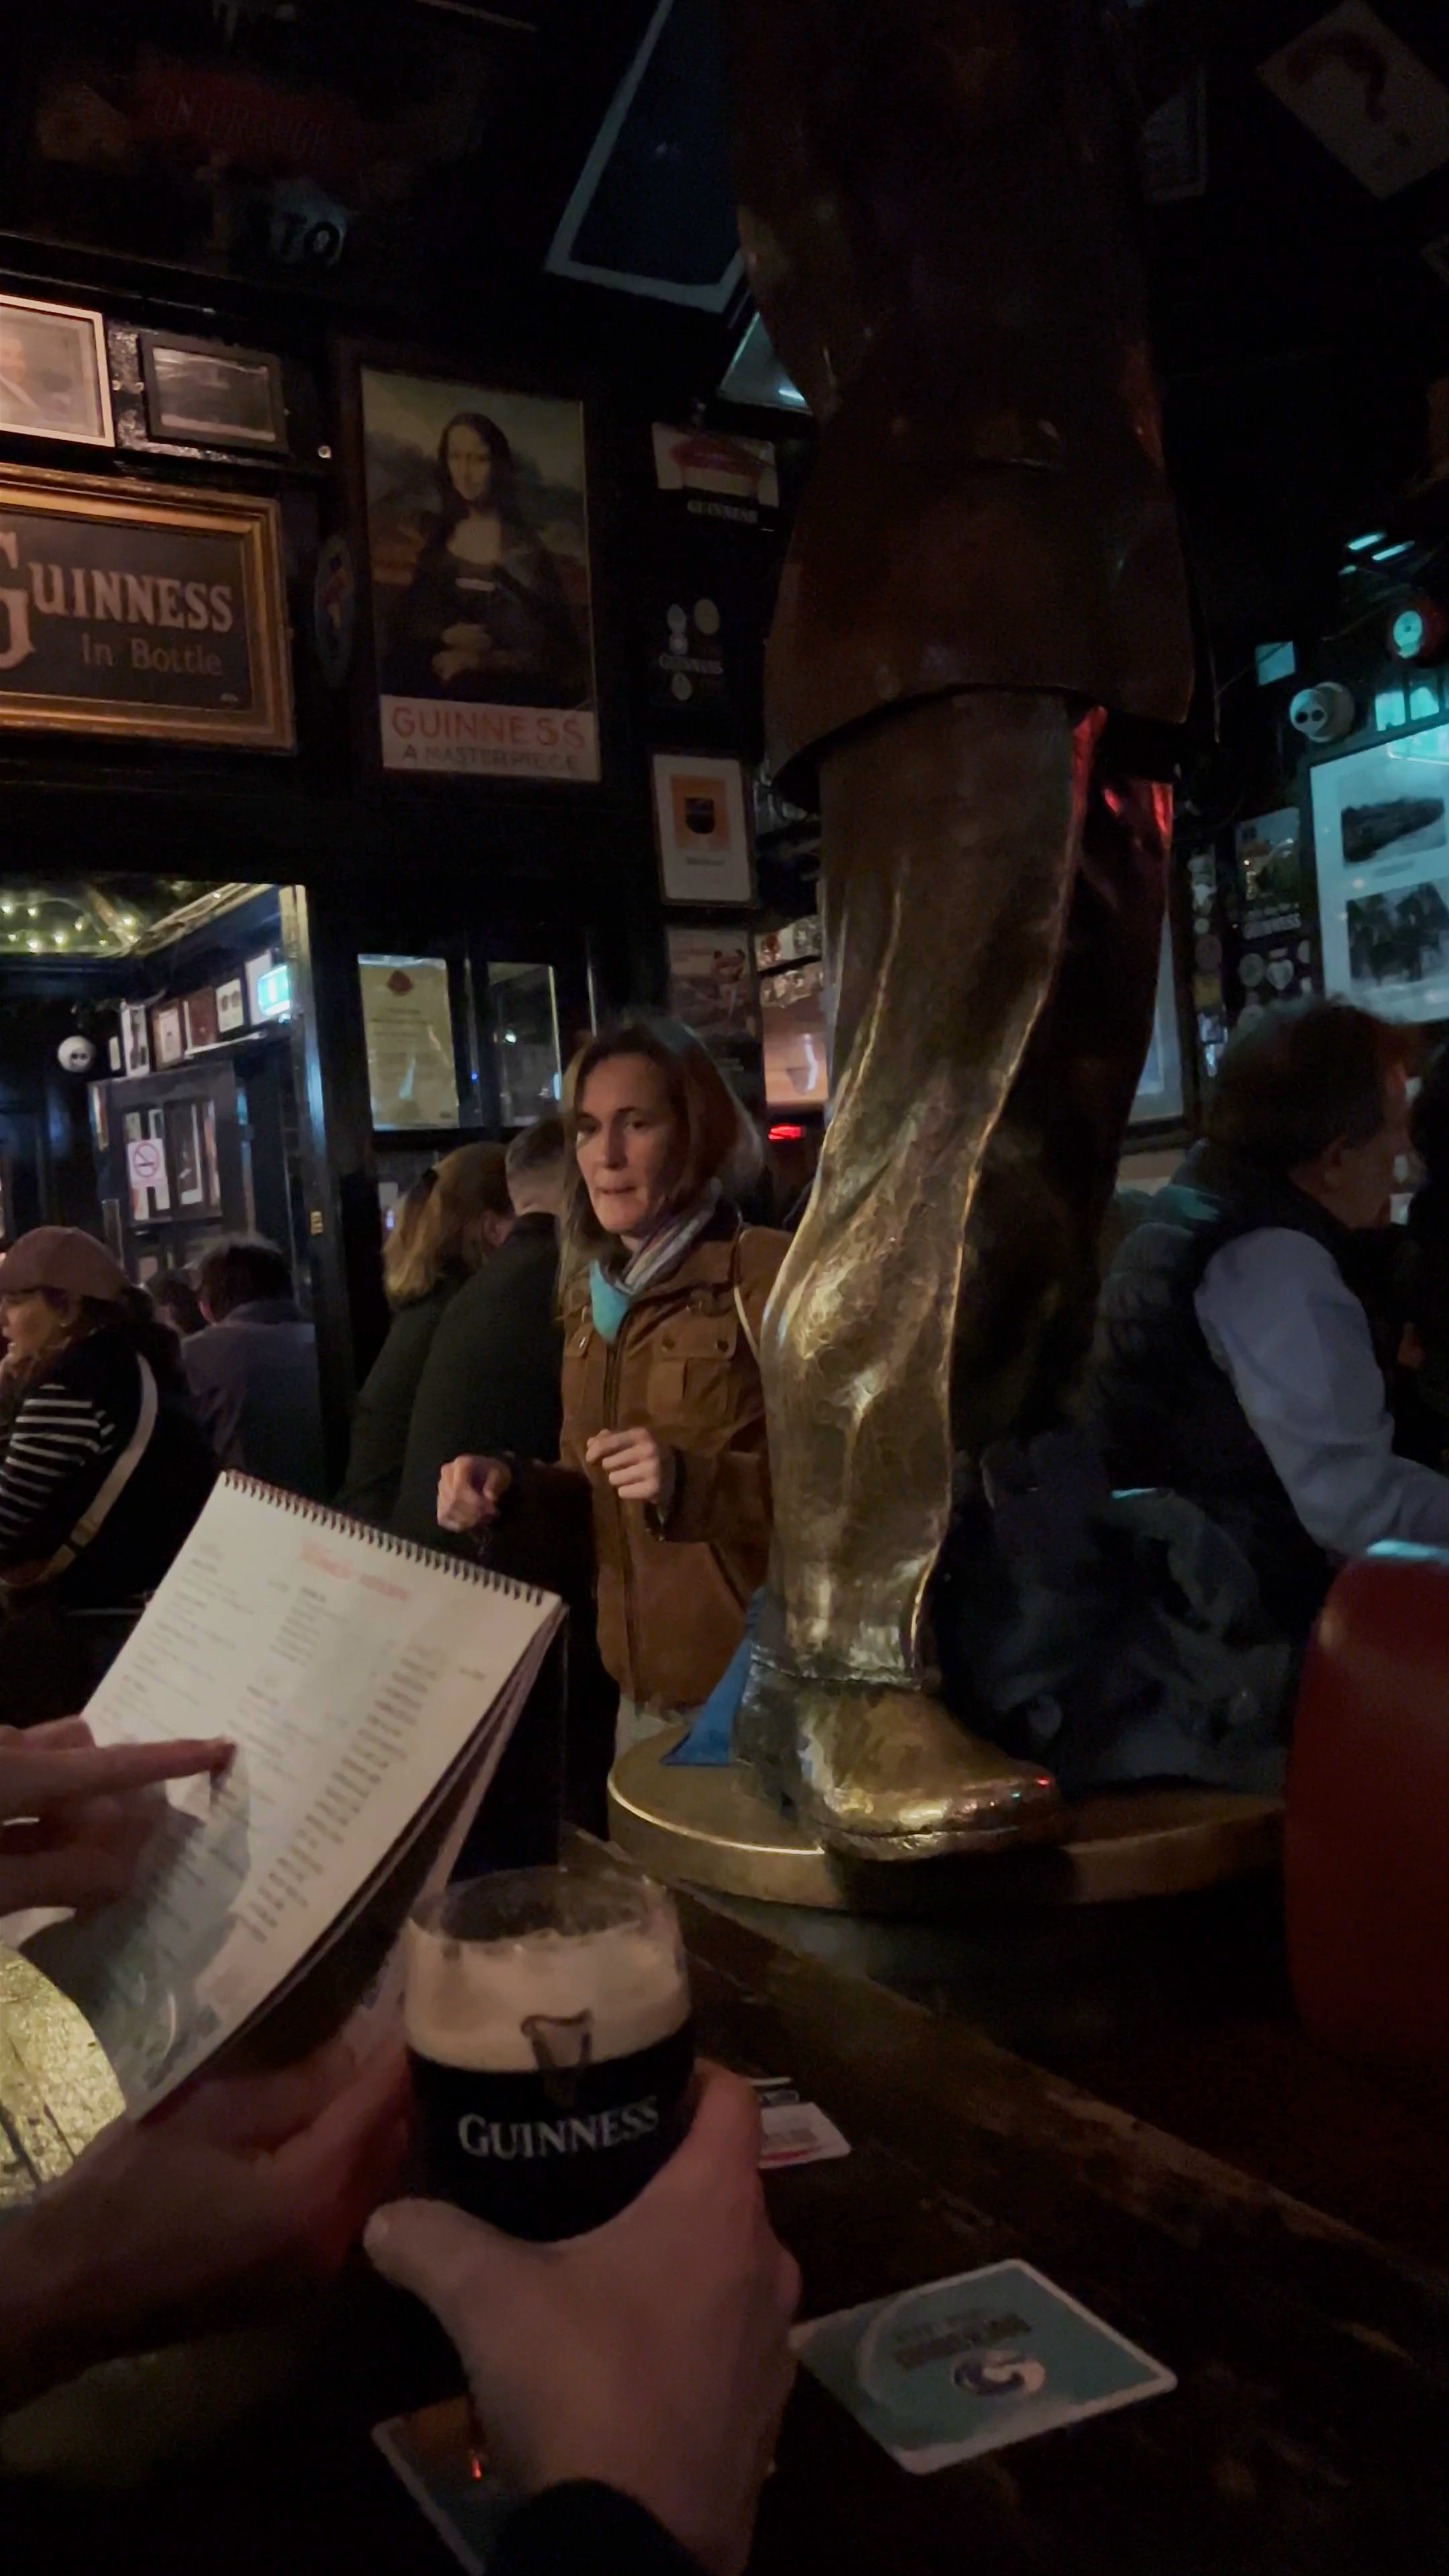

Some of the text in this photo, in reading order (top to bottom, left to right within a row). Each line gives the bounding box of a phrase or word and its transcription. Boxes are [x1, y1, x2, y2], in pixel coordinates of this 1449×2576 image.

[81, 632, 224, 677] In Bottle
[392, 706, 586, 750] GUINNESS
[403, 744, 417, 761] A
[457, 2093, 660, 2161] GUINNESS
